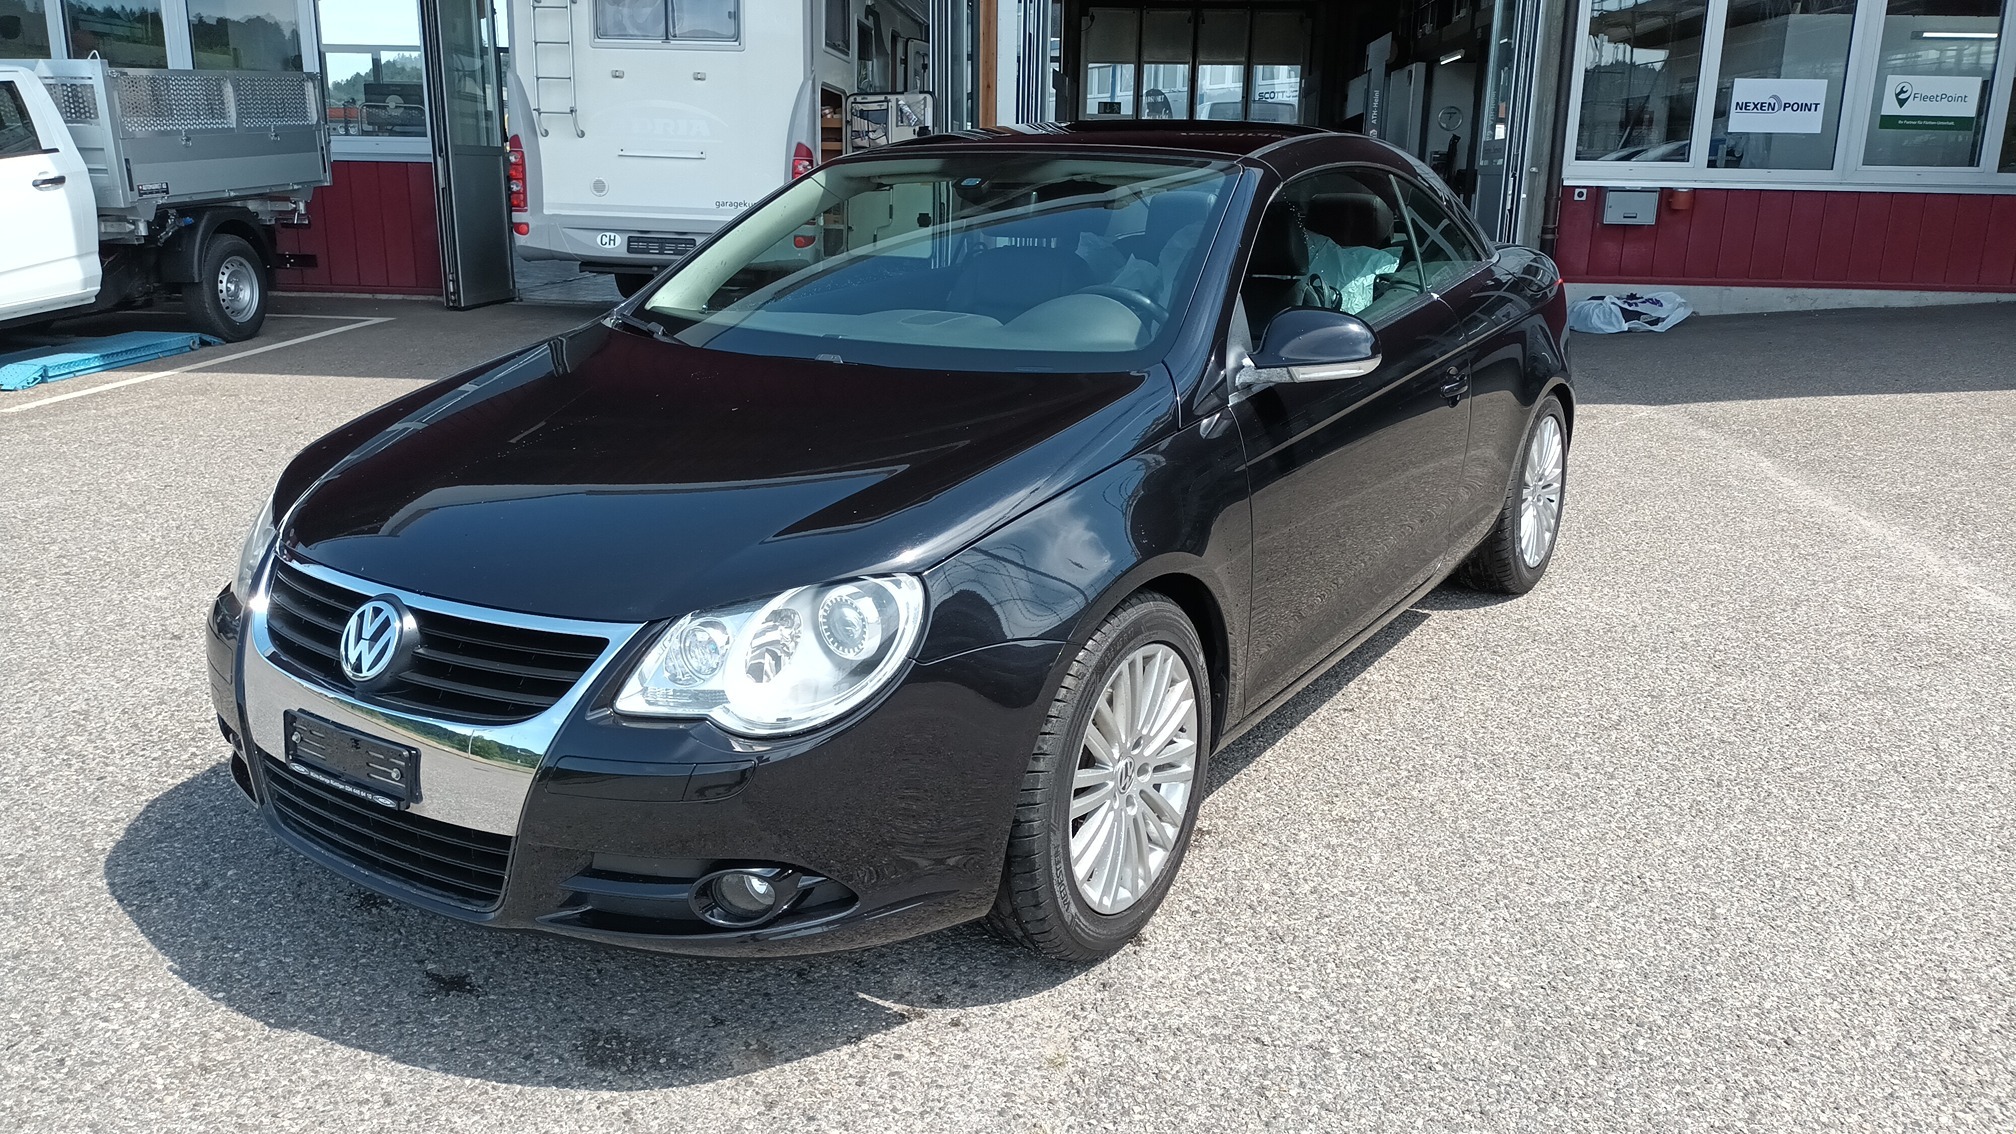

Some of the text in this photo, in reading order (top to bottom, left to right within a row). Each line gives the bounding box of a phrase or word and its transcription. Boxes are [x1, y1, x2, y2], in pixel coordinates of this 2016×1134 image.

[1912, 93, 1968, 103] FleetPoint
[1735, 101, 1820, 112] NEXEN POINT
[600, 234, 616, 246] CH
